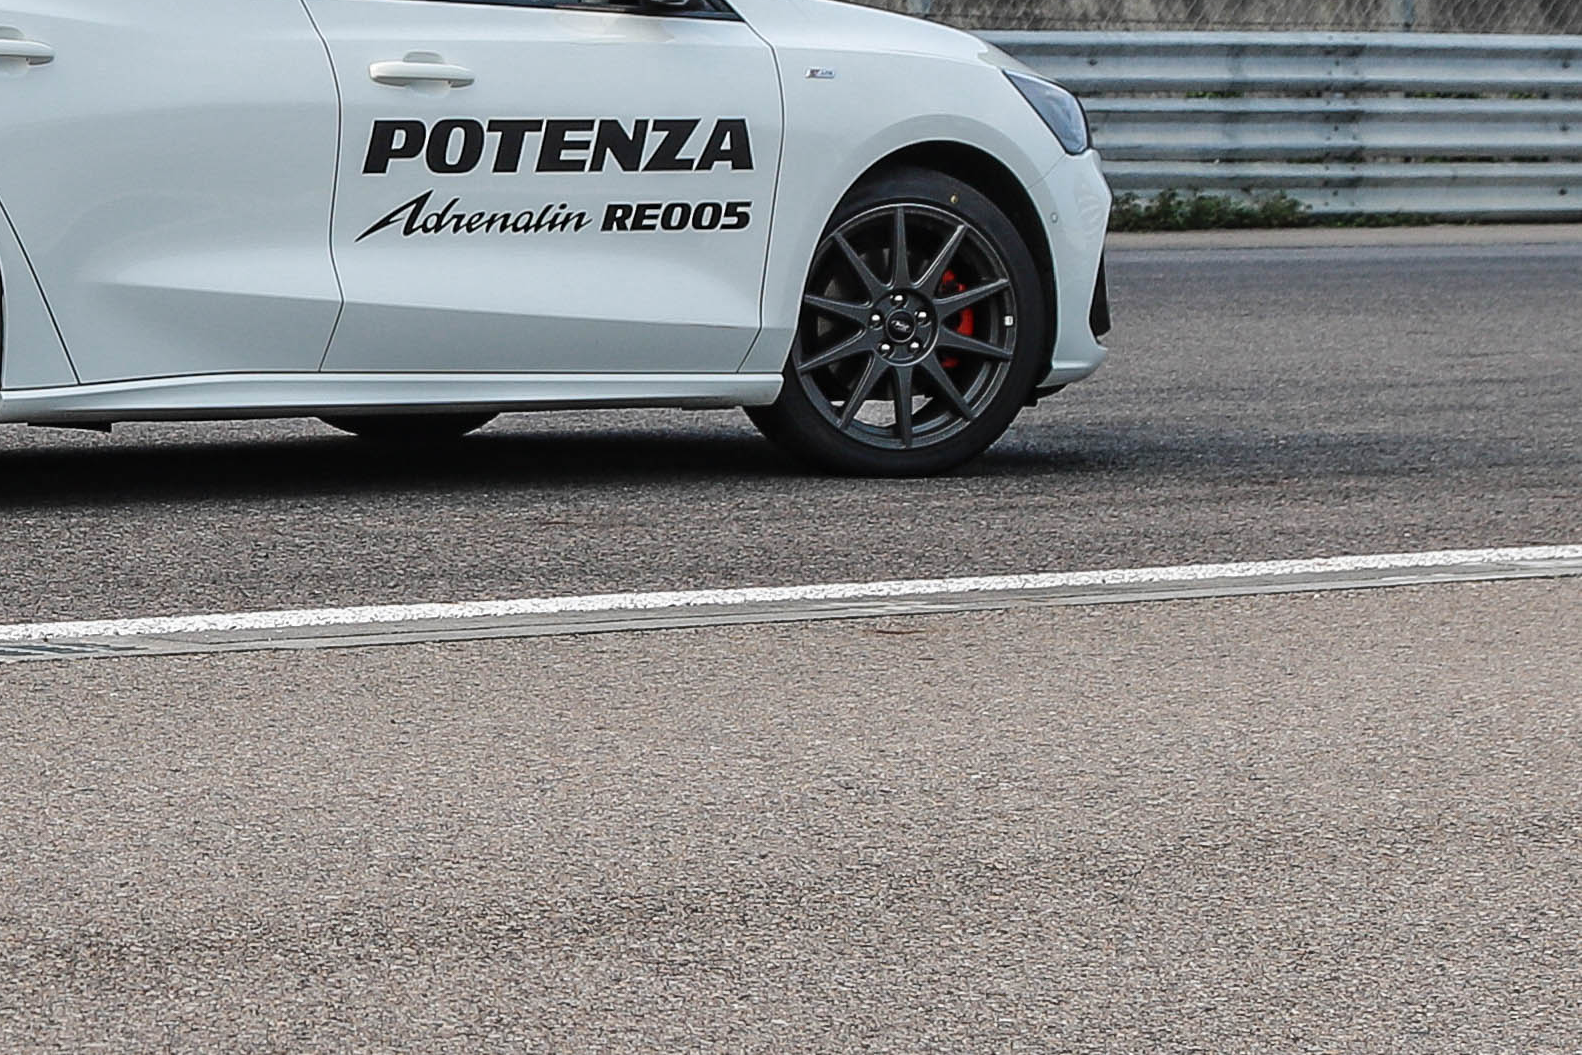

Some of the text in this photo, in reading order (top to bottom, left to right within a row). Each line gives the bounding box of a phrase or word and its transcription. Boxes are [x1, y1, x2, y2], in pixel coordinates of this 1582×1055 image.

[362, 118, 754, 174] POTENZA
[354, 189, 753, 243] Adrenalin RE005
